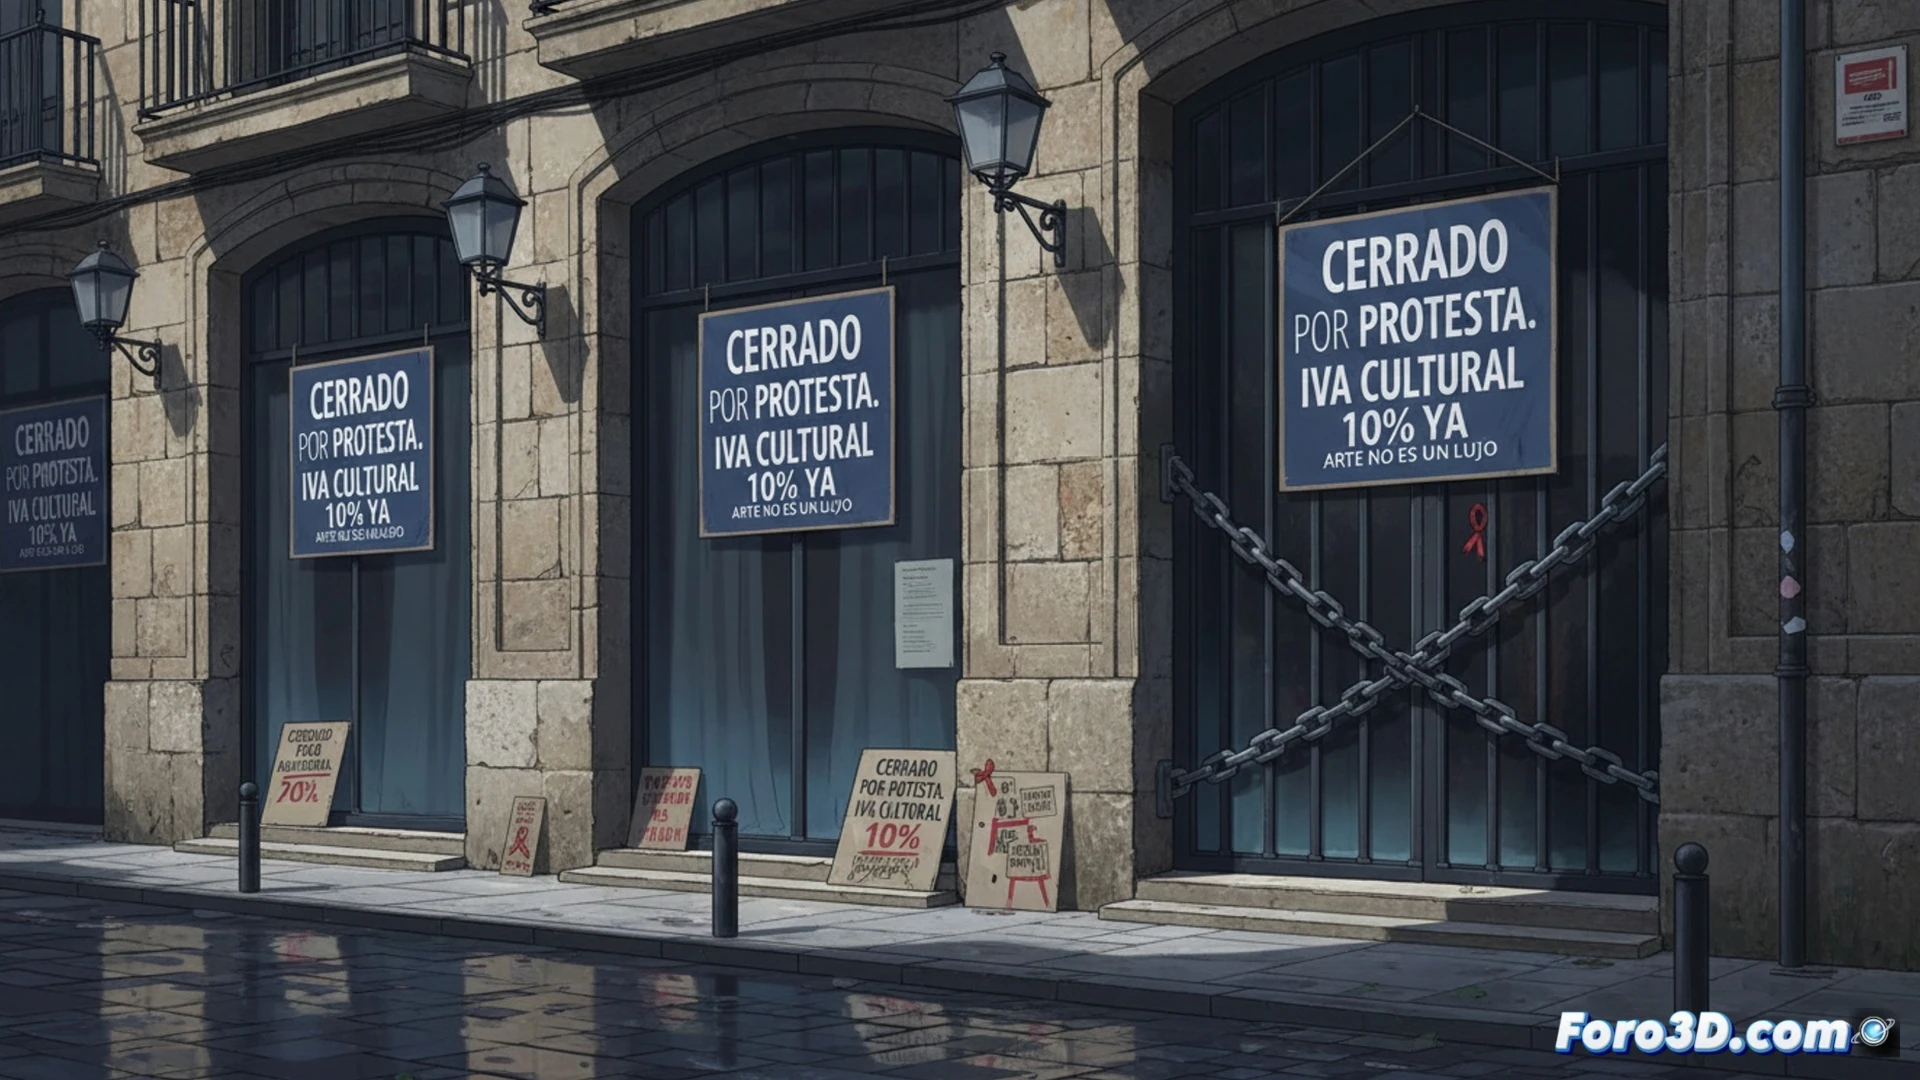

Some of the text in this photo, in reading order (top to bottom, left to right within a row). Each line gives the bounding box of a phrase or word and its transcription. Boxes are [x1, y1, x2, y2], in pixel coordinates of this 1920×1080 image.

[1322, 218, 1508, 293] CERRADO
[1295, 286, 1536, 354] POR PROTESTA.
[727, 314, 861, 375] CERRADO
[310, 370, 409, 419] CERRADO
[1302, 346, 1524, 408] IVA CULTURAL
[710, 372, 879, 423] POR PROTESTA.
[15, 416, 89, 455] CERRADO
[299, 419, 423, 462] POR PROTESTA.
[1342, 402, 1468, 447] 10% YA
[715, 422, 874, 469] IVA CULTURAL
[1323, 440, 1498, 469] ARTE NO ES UN LUJO
[6, 464, 30, 491] POR
[302, 461, 419, 501] IVA CULTURAL
[748, 466, 836, 502] 10% YA
[8, 499, 29, 523] IVA
[325, 498, 391, 528] 10% YA
[732, 504, 760, 519] ARTE
[763, 502, 780, 517] NO
[783, 501, 797, 516] ES
[799, 501, 817, 514] UN
[59, 522, 77, 543] YA
[866, 822, 921, 849] 10%
